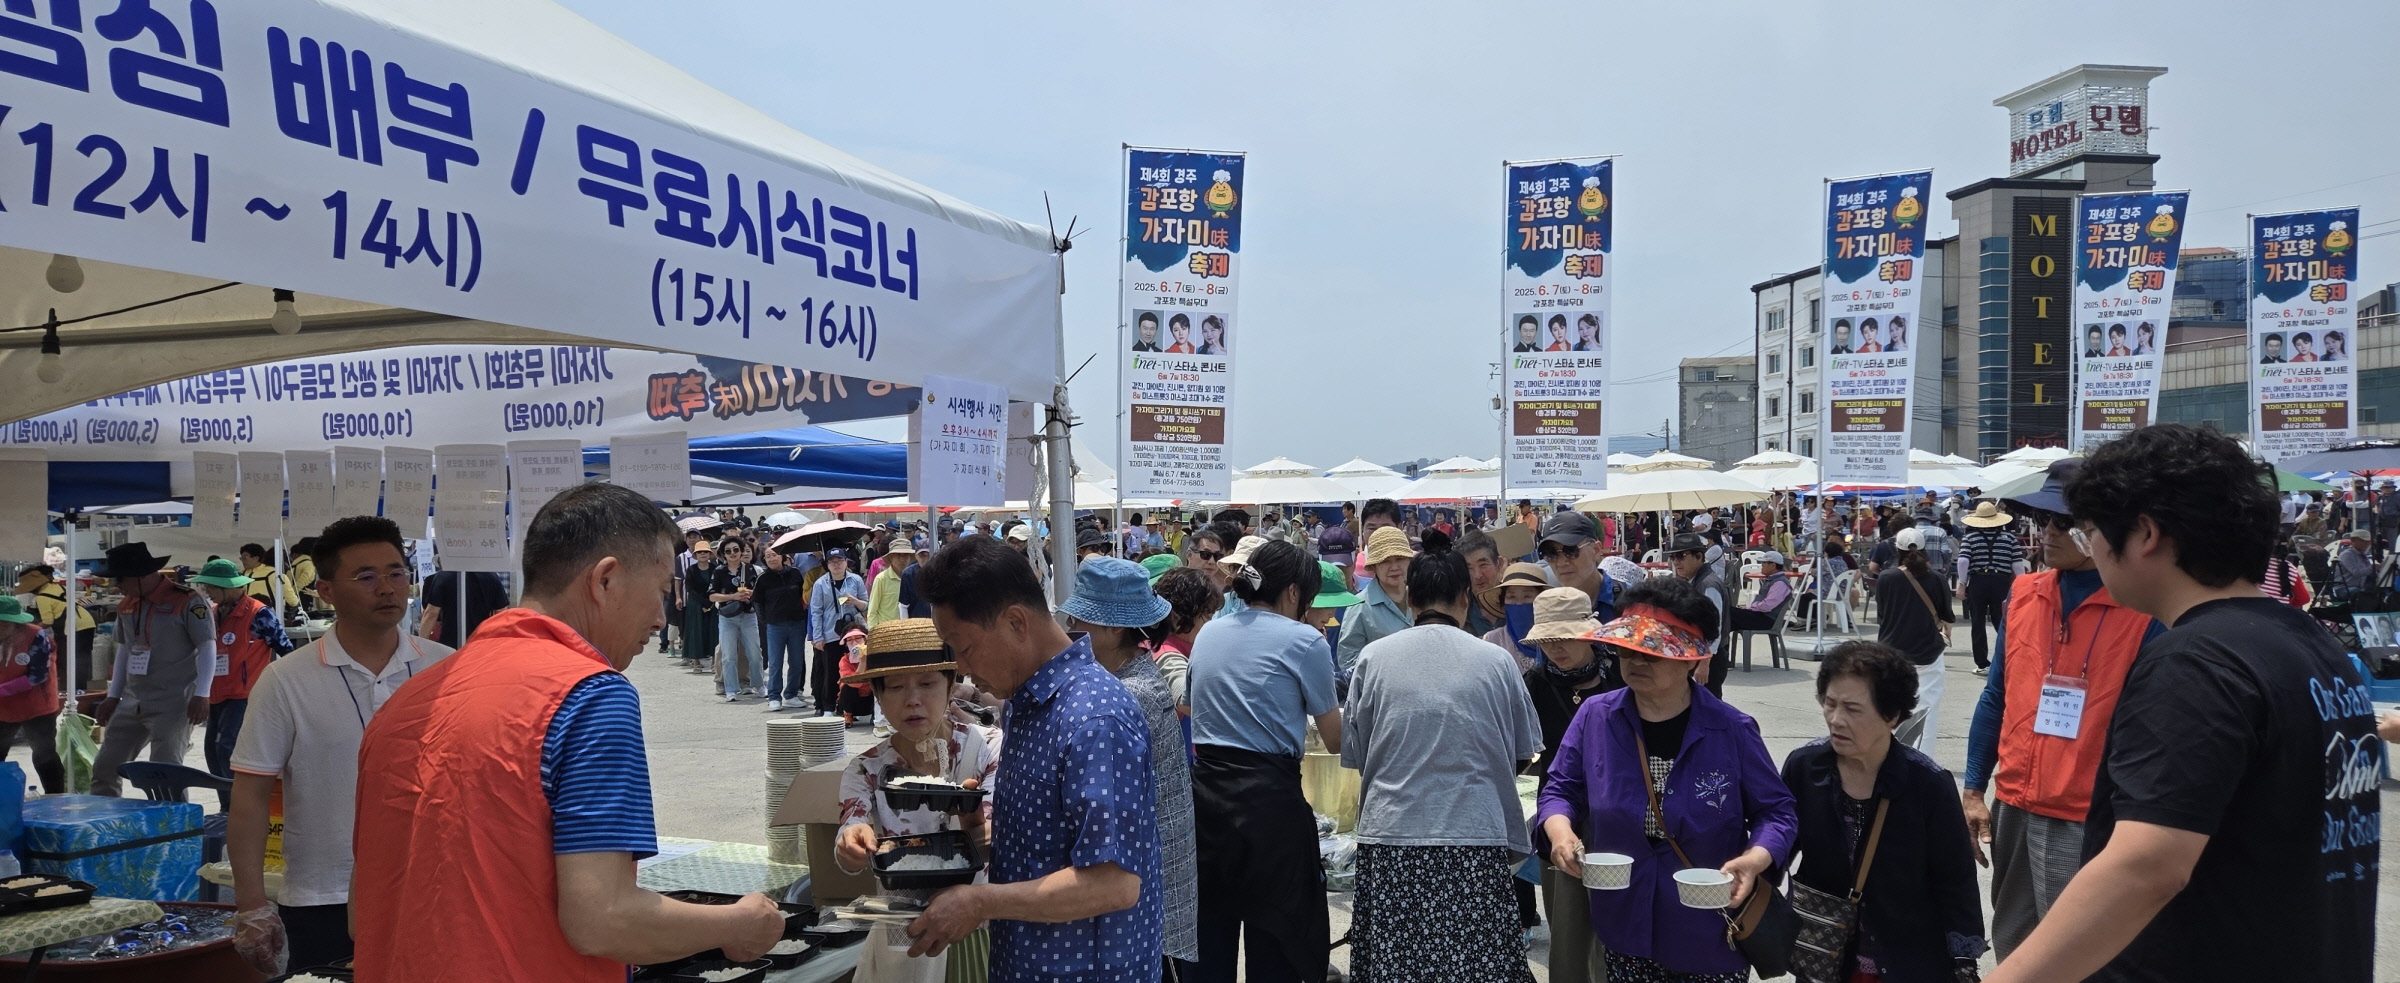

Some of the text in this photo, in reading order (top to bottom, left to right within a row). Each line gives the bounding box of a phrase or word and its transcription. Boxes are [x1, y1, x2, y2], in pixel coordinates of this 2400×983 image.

[2010, 121, 2083, 163] MOTEL
[267, 26, 480, 184] 배부
[510, 107, 546, 196] /
[576, 123, 919, 302] 무료시식코너
[1139, 167, 1197, 184] 제4회 경주
[1519, 177, 1571, 195] 제4회 경주
[1139, 187, 1199, 213] 감포항
[1519, 196, 1572, 222] 감포항
[1836, 190, 1888, 207] 제4회 경주
[1836, 207, 1888, 232] 감포항
[2088, 206, 2142, 221] 제4회 경주
[245, 197, 292, 221] ~
[322, 189, 483, 292] 14시)
[2087, 222, 2141, 244] 감포항
[2262, 224, 2316, 238] 제4회 경주
[2263, 239, 2317, 260] 감포항
[1190, 252, 1229, 277] 축제
[1566, 255, 1602, 278] 축제
[1880, 260, 1913, 283] 축제
[2128, 271, 2165, 292] 축제
[2311, 283, 2347, 303] 축제
[651, 257, 877, 362] (15시 ~ 16시)
[2028, 214, 2058, 405] MOTEL
[1174, 361, 1199, 372] 스타쇼
[1200, 362, 1227, 373] 콘서트
[1554, 358, 1575, 368] 스타쇼
[1576, 358, 1602, 368] 콘서트
[947, 396, 1002, 422] 시식행사 시간
